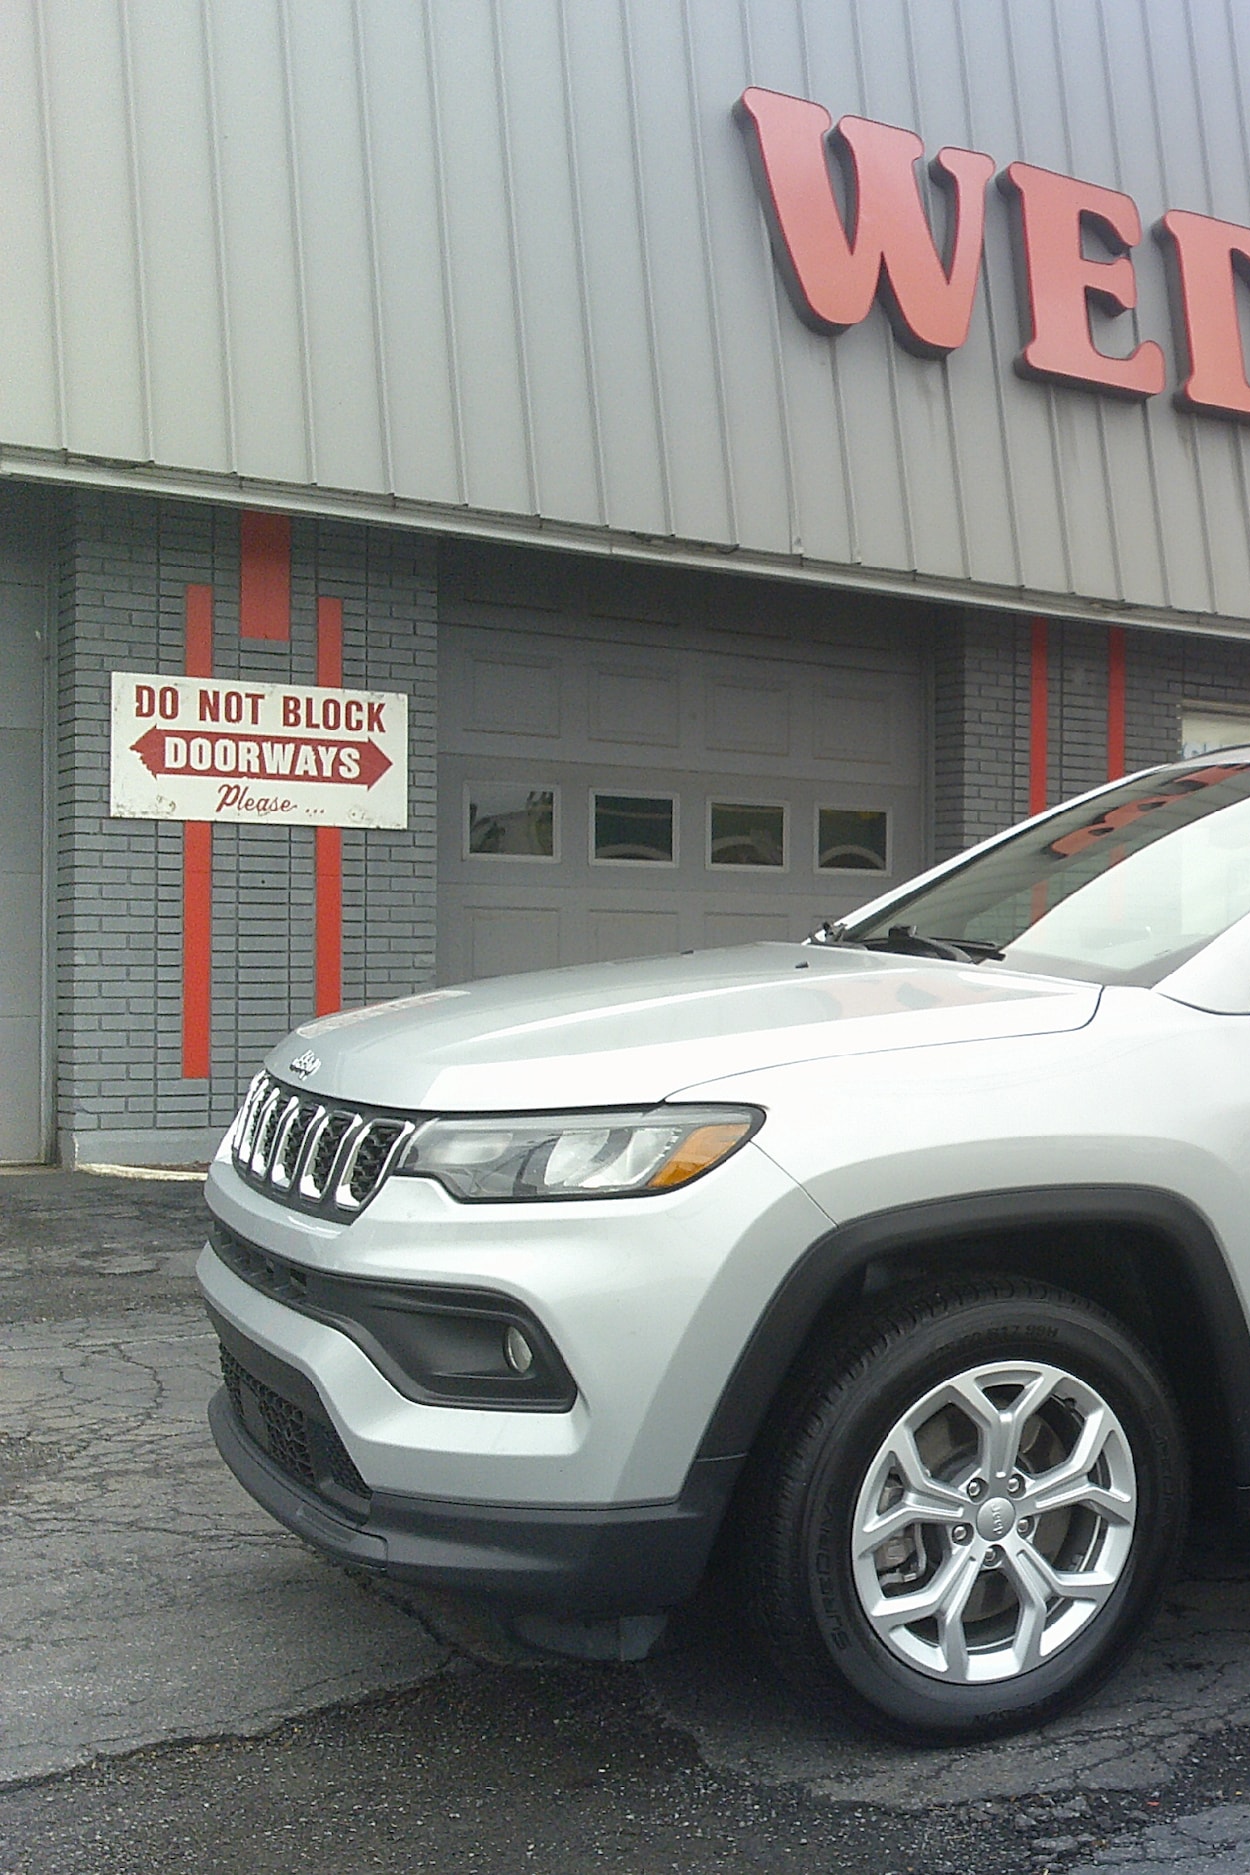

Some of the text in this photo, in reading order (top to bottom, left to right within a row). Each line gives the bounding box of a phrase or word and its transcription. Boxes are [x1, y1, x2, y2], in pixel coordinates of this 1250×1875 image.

[135, 684, 386, 733] DO NOT BLOCK
[165, 736, 361, 779] DOORWAYS
[215, 784, 298, 813] Please
